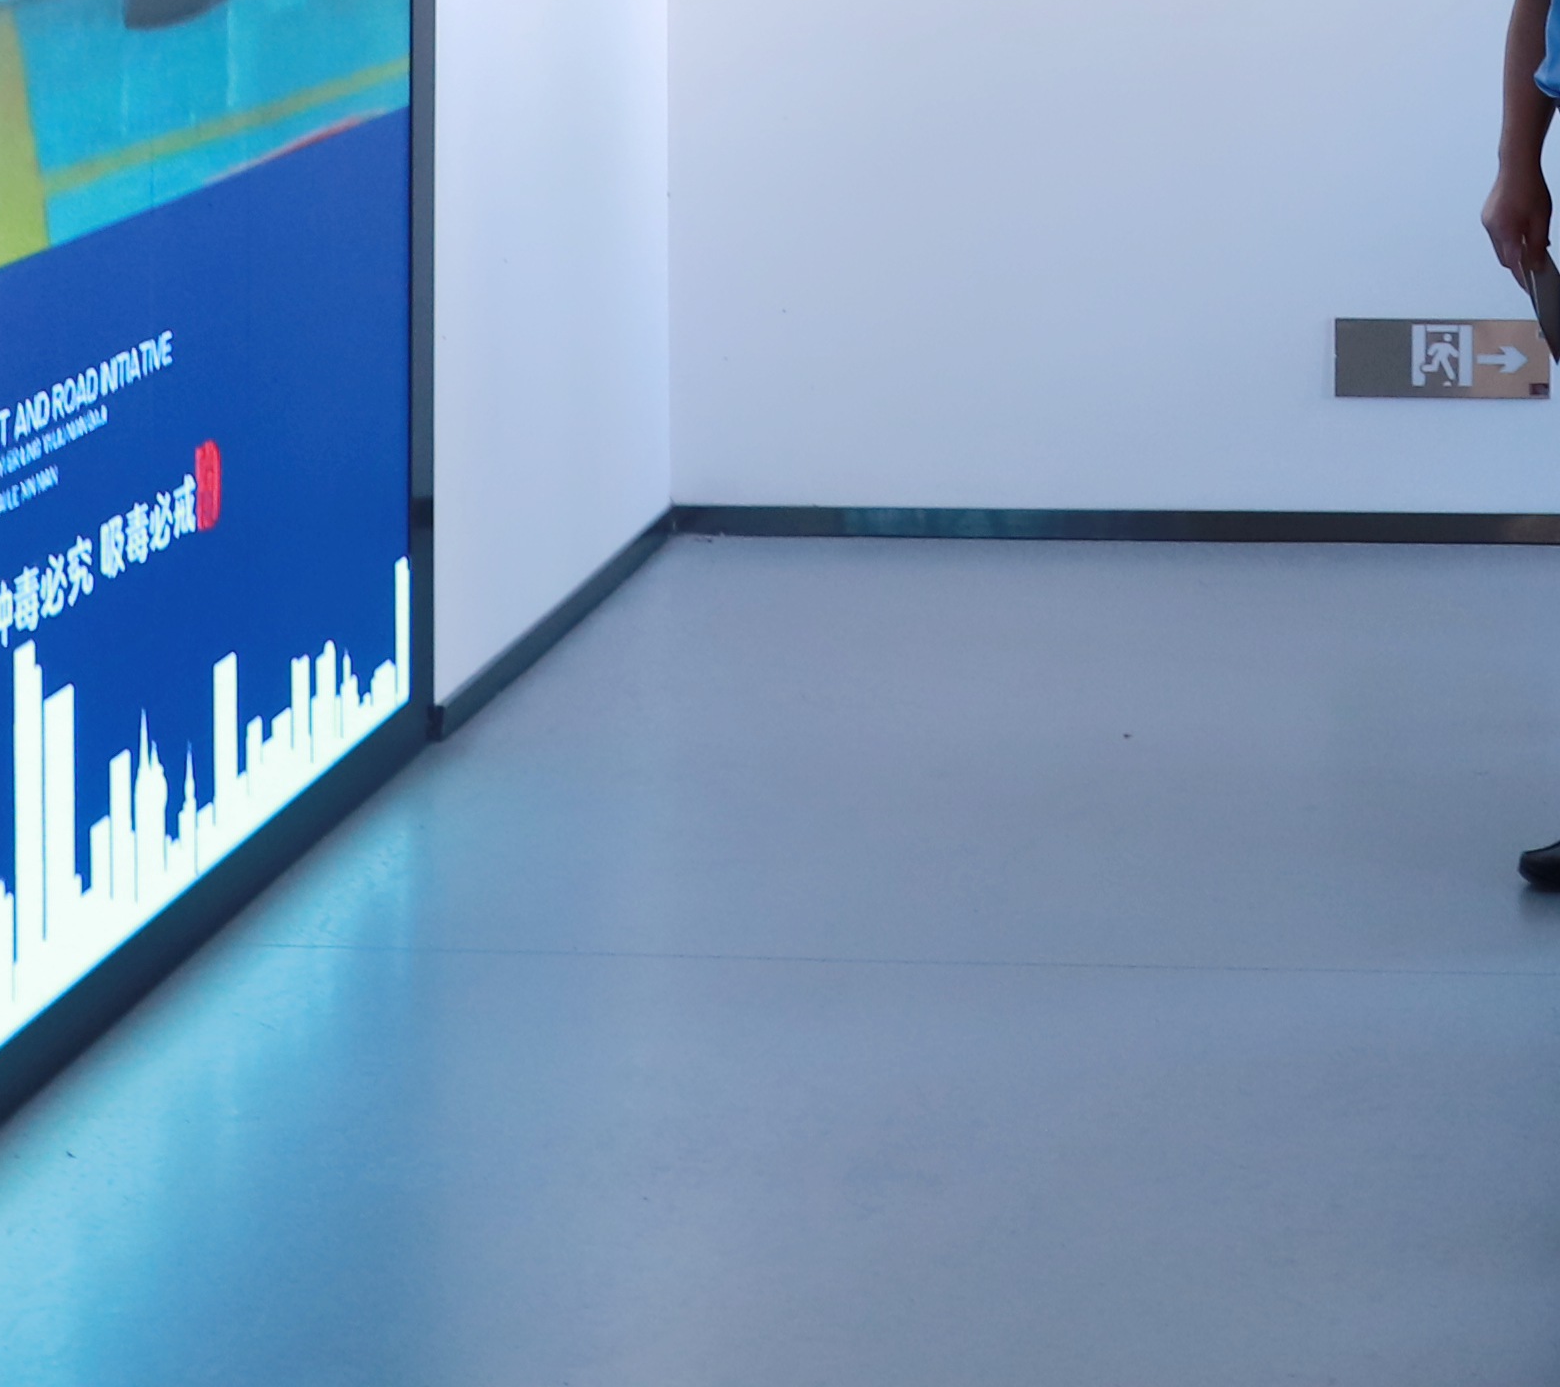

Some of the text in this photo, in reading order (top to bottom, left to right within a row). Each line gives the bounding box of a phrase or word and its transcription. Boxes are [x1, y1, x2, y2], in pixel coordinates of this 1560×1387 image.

[13, 390, 51, 442] AND
[52, 366, 99, 422] ROAD
[99, 473, 197, 579] 吸毒必戒
